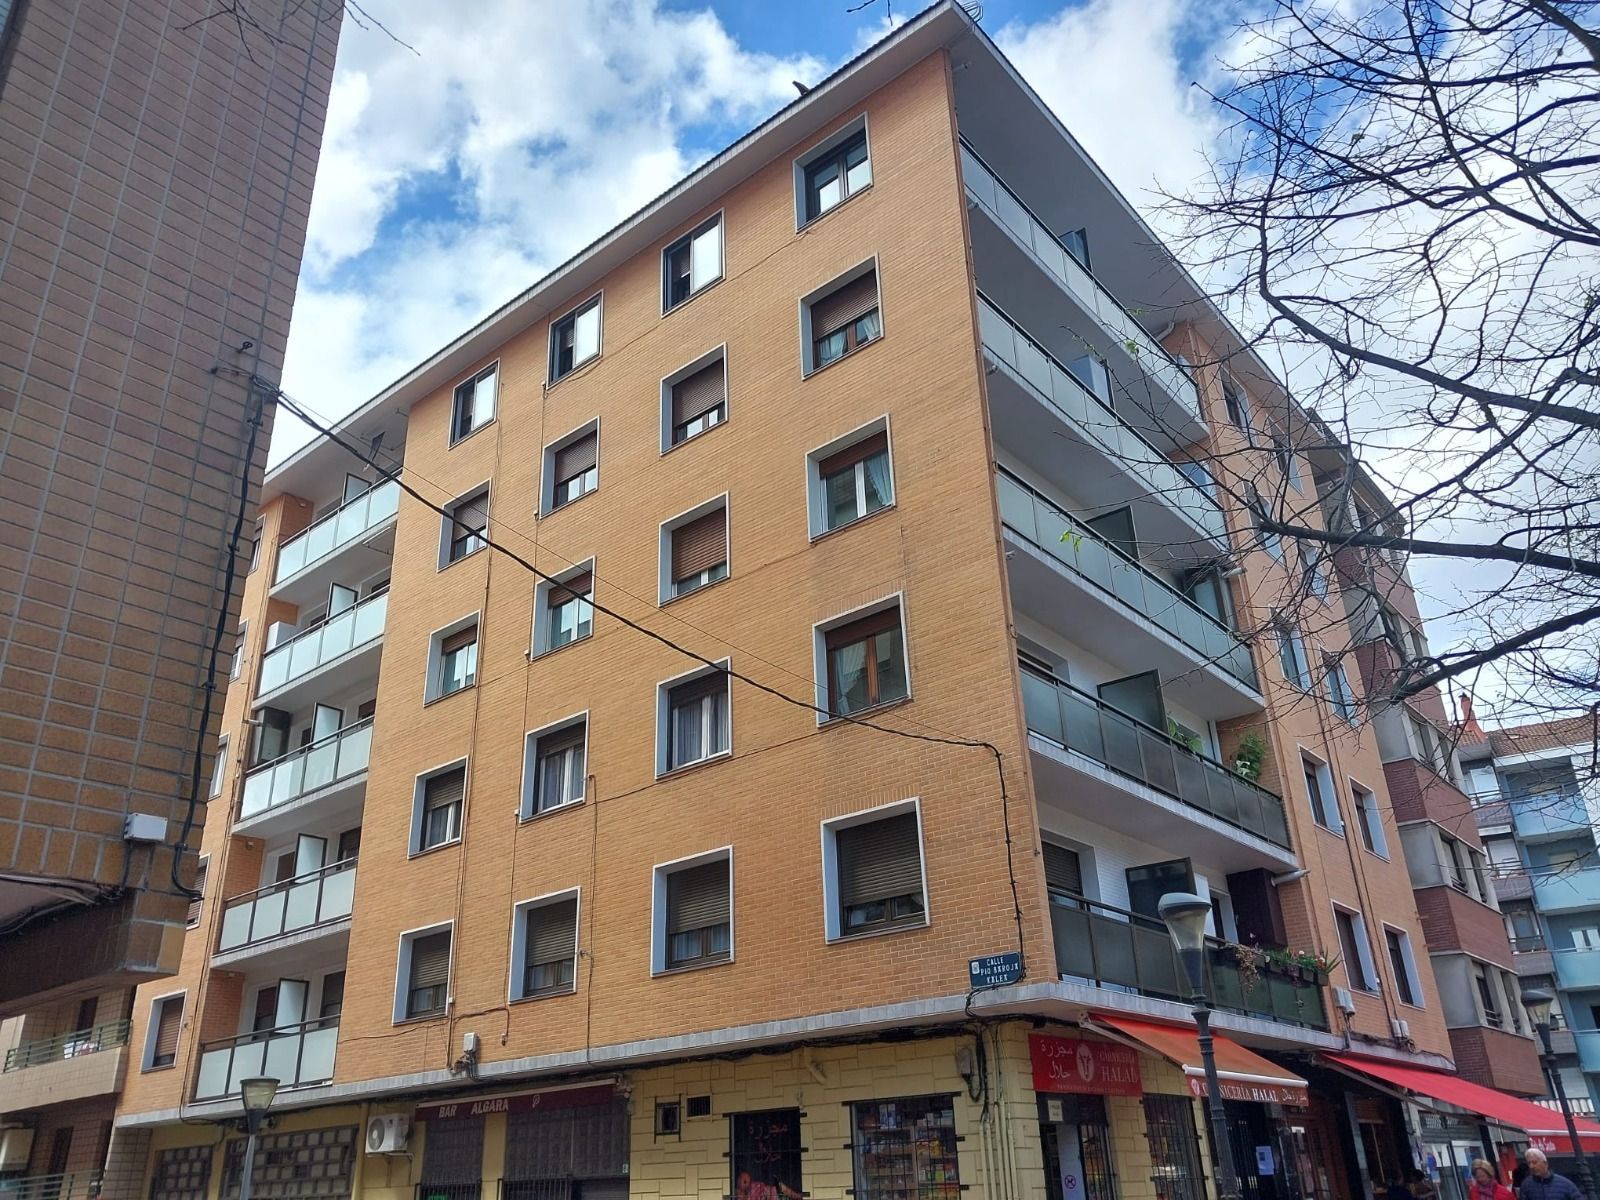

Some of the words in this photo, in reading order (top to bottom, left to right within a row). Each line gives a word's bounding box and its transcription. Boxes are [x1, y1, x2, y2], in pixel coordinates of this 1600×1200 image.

[986, 957, 1004, 966] CALLE
[993, 962, 1019, 973] BAROJA
[986, 974, 1008, 983] KALEA
[1048, 1060, 1071, 1079] حلال
[1102, 1065, 1138, 1083] HALAL
[1201, 1082, 1252, 1101] CNICERÍA
[1251, 1087, 1279, 1102] HALAL
[438, 1104, 457, 1118] BAR
[470, 1098, 509, 1115] ALGARA
